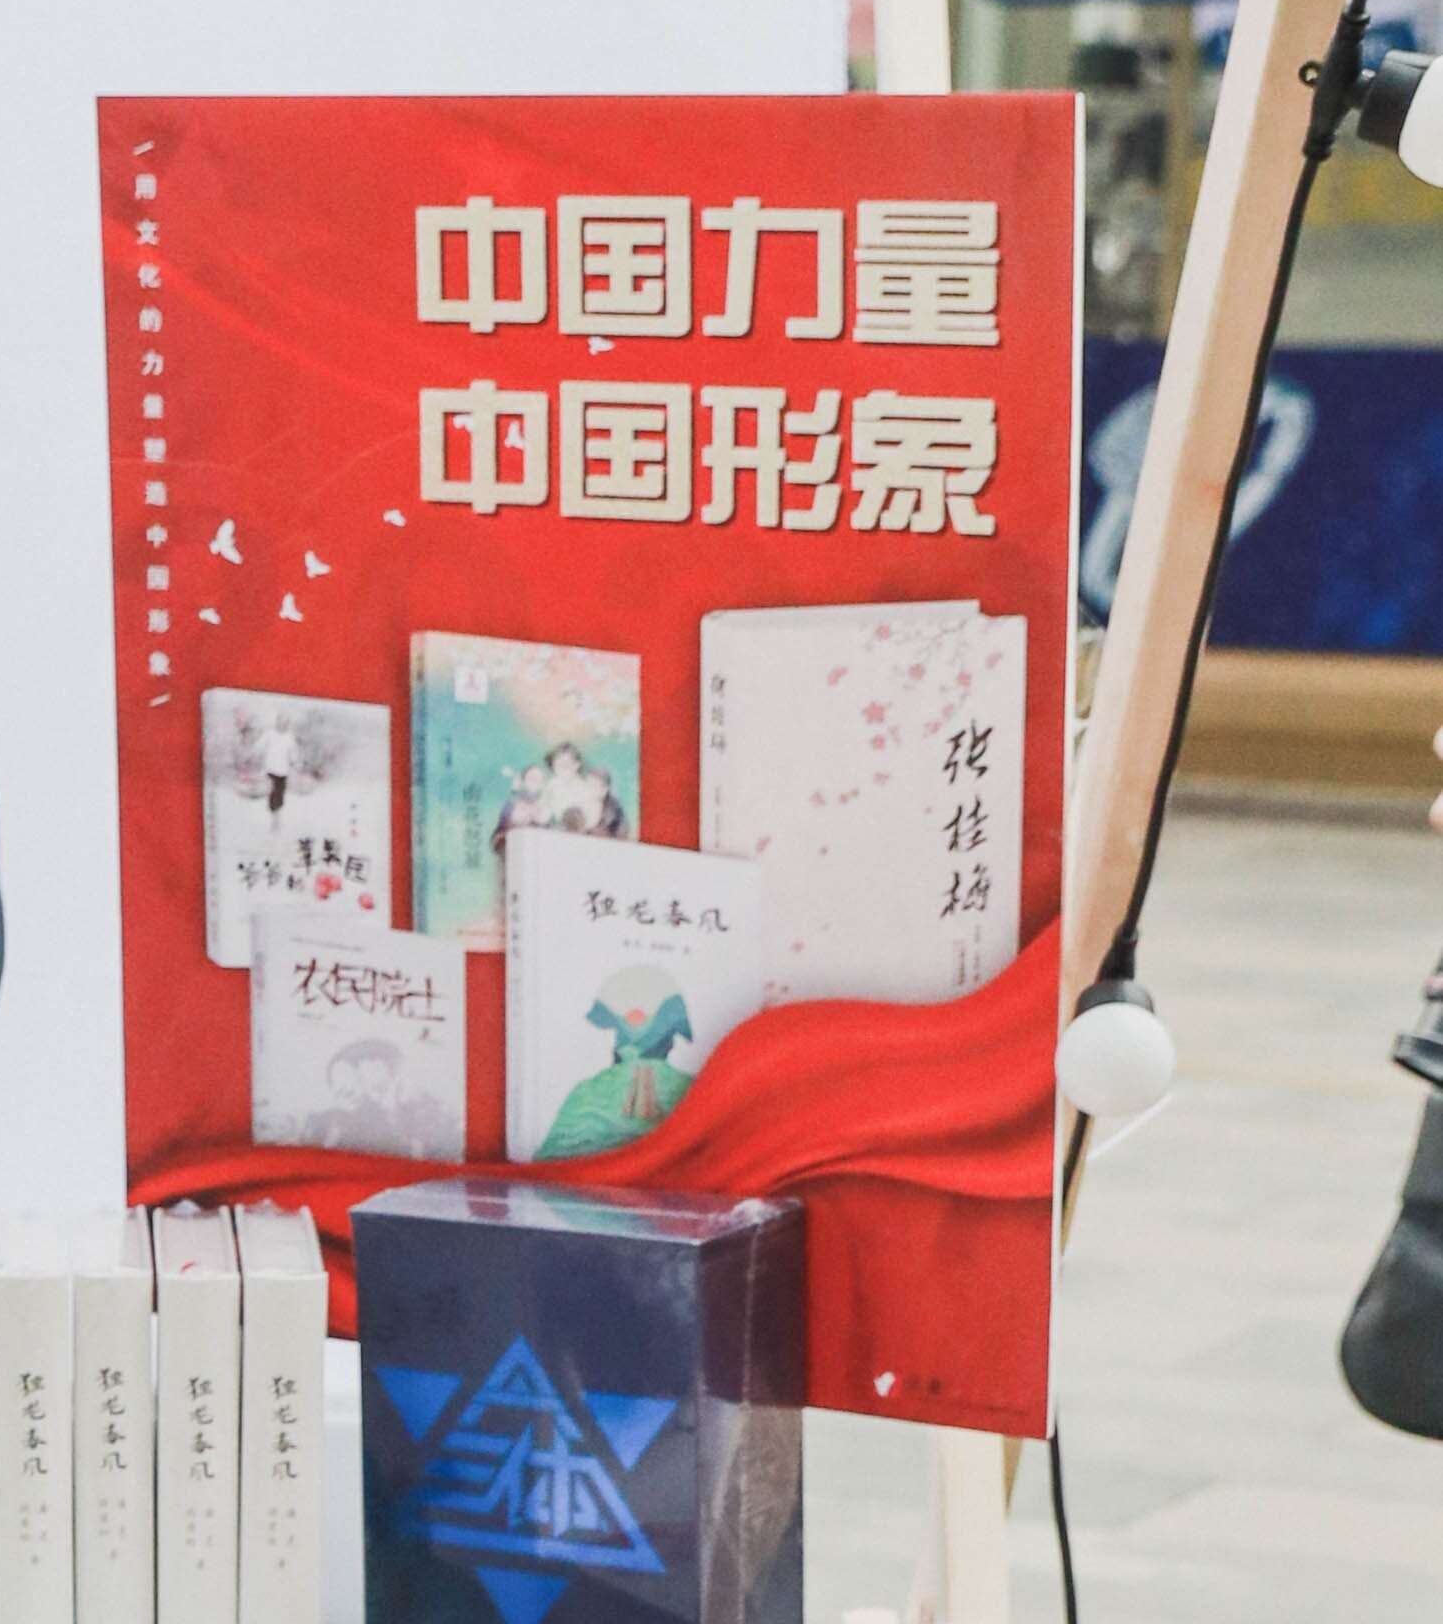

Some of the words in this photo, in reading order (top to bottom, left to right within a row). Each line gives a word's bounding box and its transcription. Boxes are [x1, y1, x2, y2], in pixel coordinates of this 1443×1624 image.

[416, 195, 1000, 347] 中国力量
[418, 379, 997, 537] 中国形象
[940, 719, 993, 919] 张桂梅
